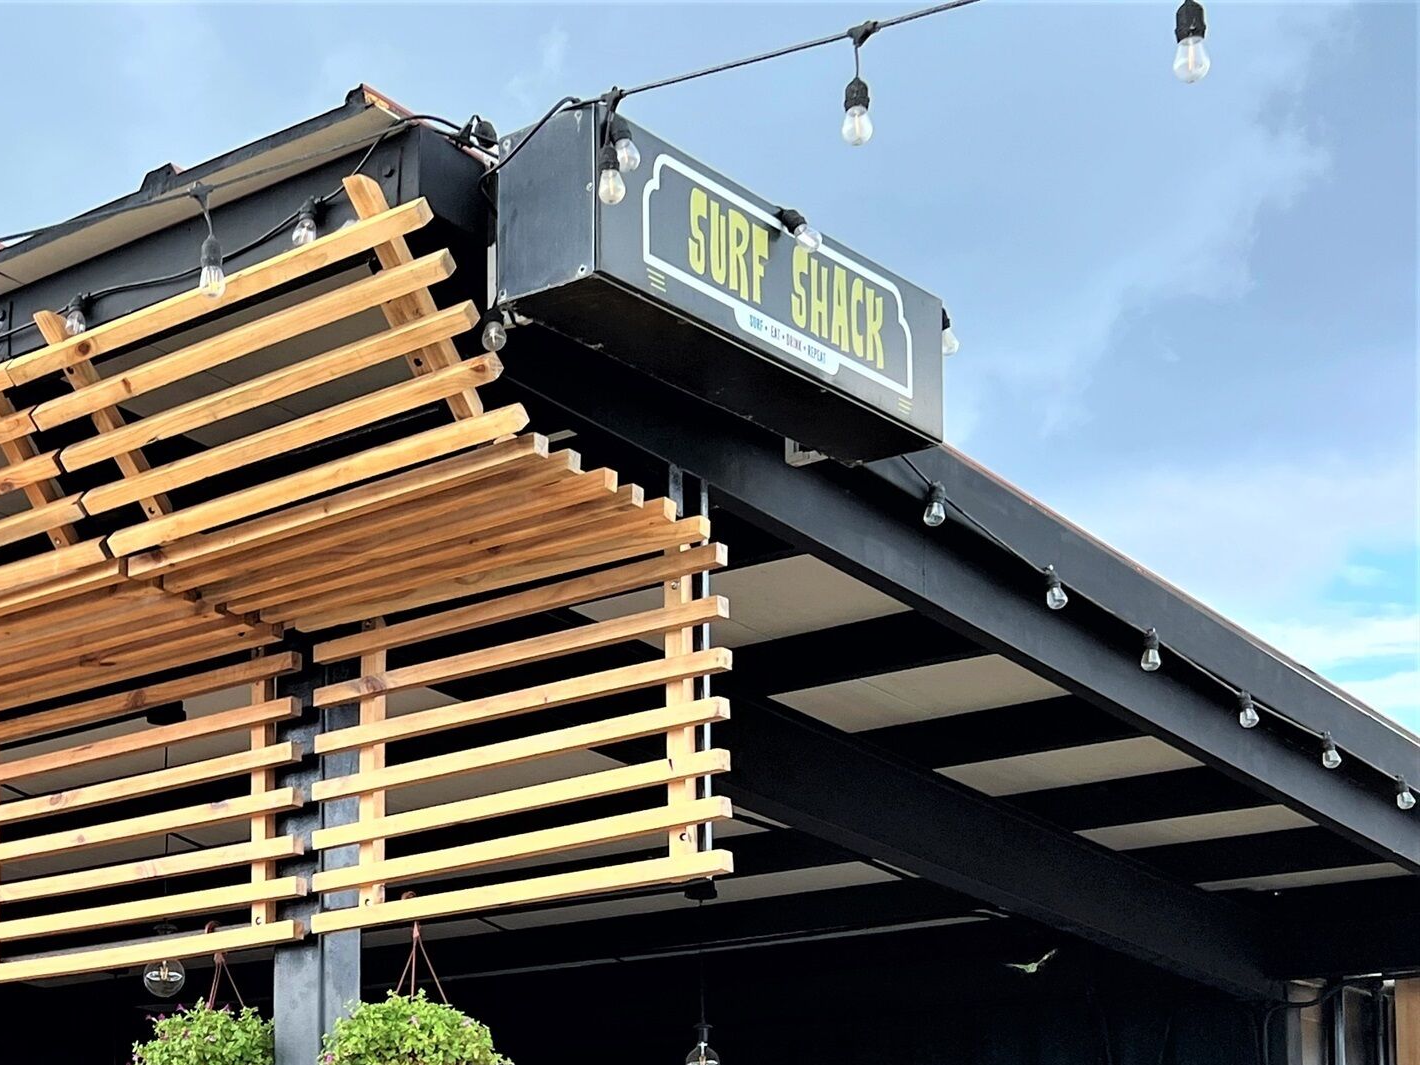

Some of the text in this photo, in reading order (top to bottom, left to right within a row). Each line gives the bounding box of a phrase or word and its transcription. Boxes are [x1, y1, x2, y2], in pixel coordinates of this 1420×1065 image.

[688, 187, 884, 369] SURF SHACK
[770, 325, 781, 340] EAT
[786, 333, 802, 352] DRINK
[807, 344, 826, 364] REPEAT
